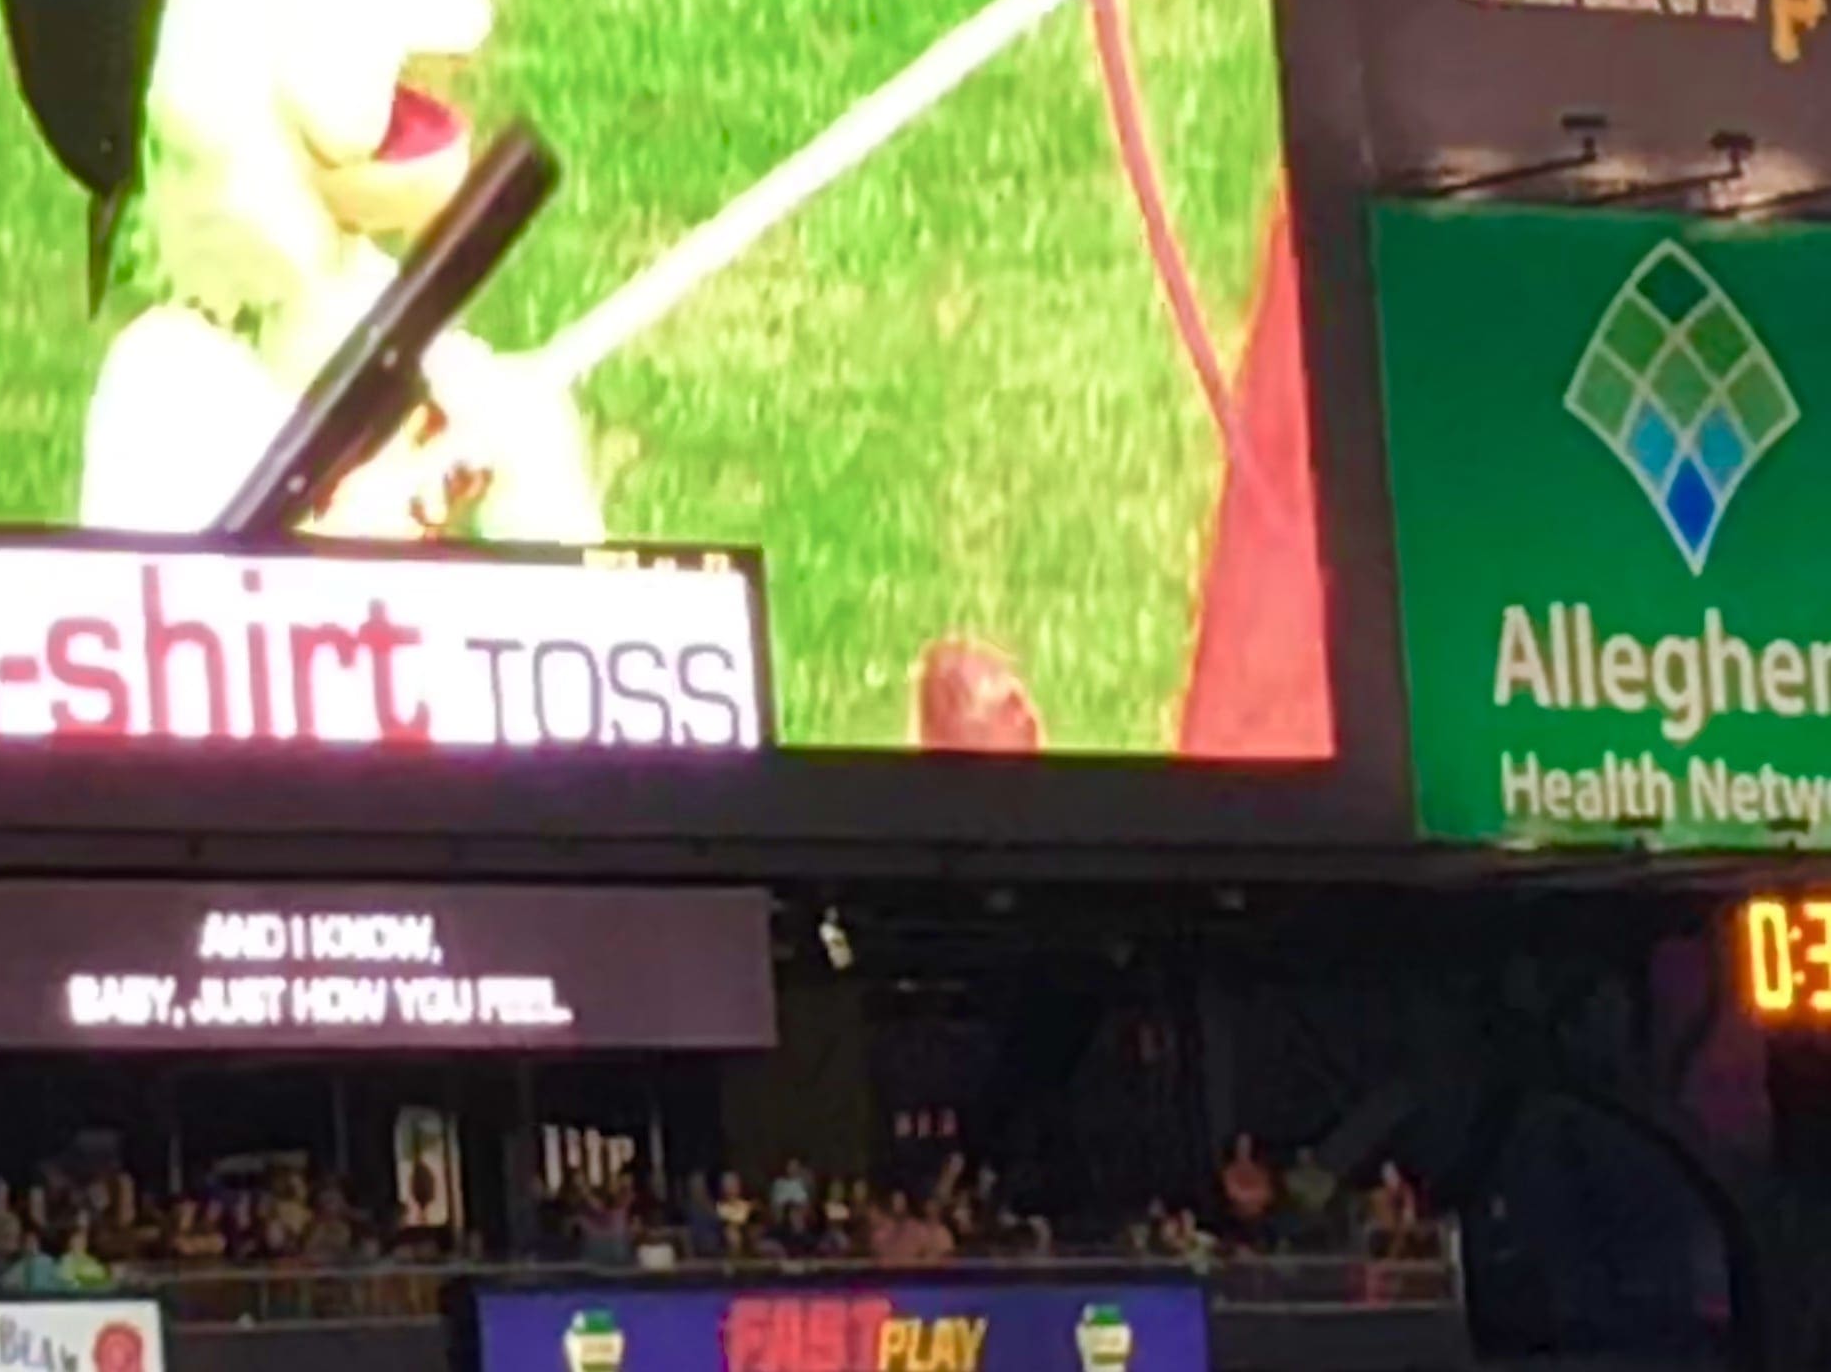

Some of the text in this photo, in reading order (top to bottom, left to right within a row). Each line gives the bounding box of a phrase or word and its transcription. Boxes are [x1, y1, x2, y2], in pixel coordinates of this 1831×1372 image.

[464, 636, 742, 748] TOSS
[1500, 748, 1676, 823] Health
[198, 910, 287, 961] AND
[290, 914, 307, 961] I
[189, 975, 287, 1025] JUST
[290, 976, 388, 1025] HOW
[390, 976, 474, 1026] YOU
[726, 1297, 988, 1372] FAST PLAY
